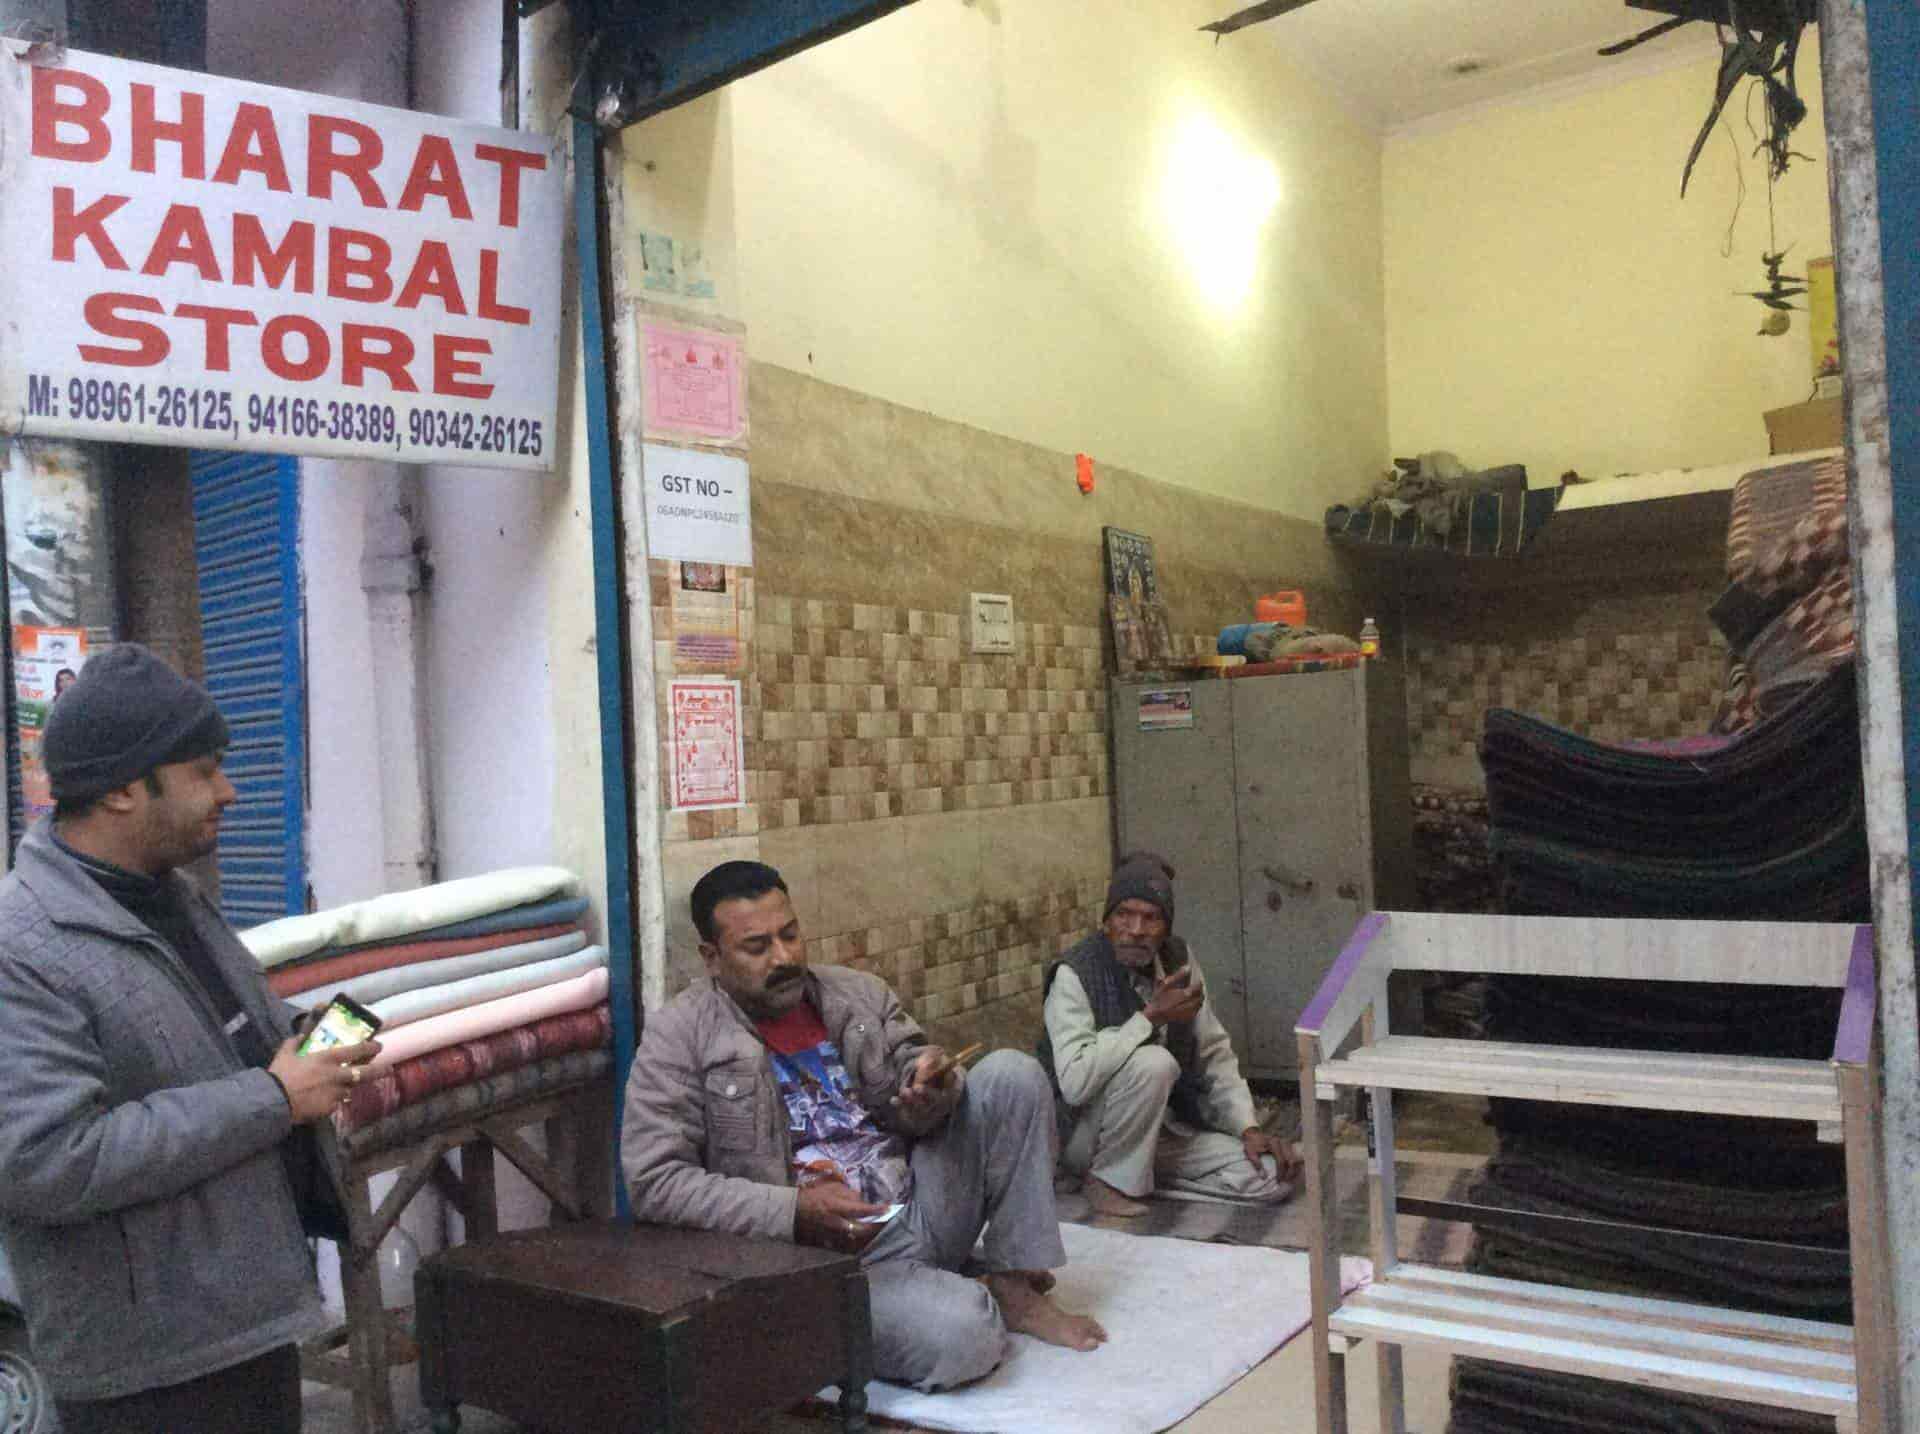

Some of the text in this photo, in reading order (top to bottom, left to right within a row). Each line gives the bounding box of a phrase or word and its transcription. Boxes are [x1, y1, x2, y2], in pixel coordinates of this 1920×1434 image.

[32, 65, 547, 228] BHARAT
[52, 187, 531, 325] KAMBAL
[77, 292, 495, 400] STORE
[28, 374, 543, 457] M: 98961-26125, 94166-38389, 90342-26125
[662, 474, 692, 494] GST
[696, 479, 720, 497] NO
